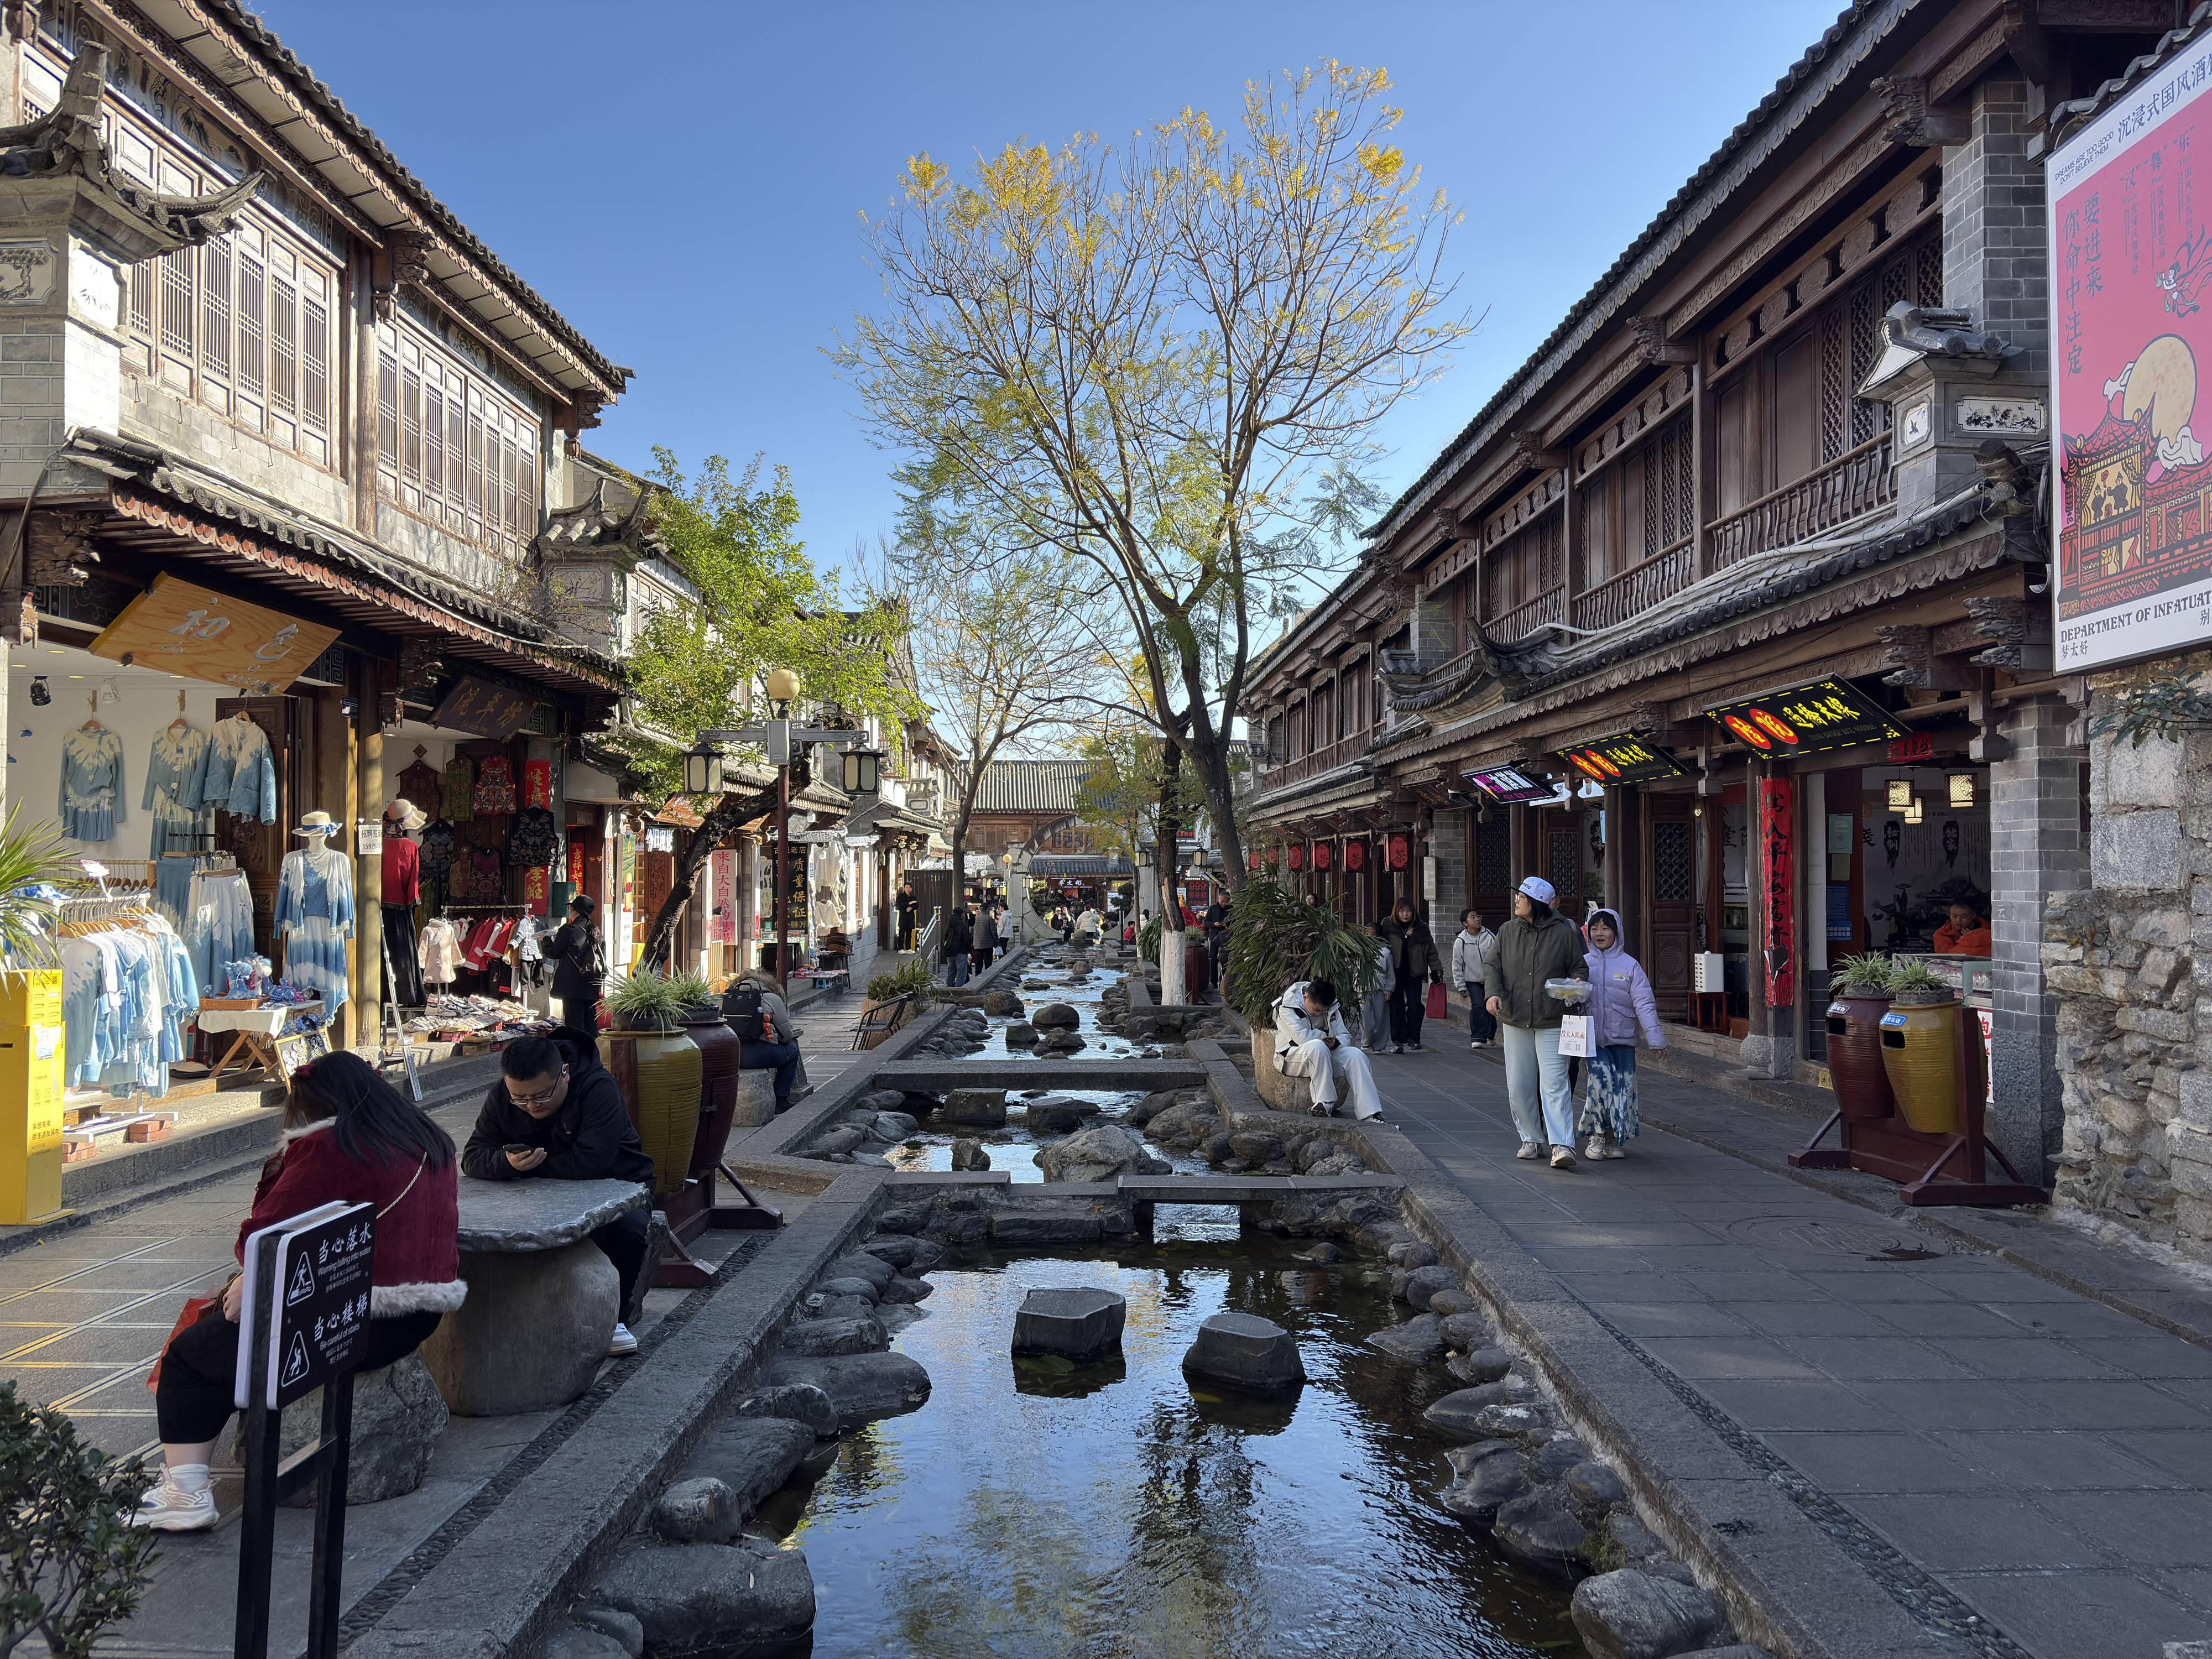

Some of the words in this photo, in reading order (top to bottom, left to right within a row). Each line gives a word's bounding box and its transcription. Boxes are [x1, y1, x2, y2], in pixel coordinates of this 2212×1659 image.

[2055, 161, 2075, 180] DREAMS
[2075, 153, 2085, 165] ARE
[2086, 144, 2097, 157] TOO
[2098, 131, 2114, 148] GOOD
[2060, 170, 2075, 185] DON'T
[2075, 155, 2094, 176] BELIEVE
[2095, 144, 2109, 159] THEM
[2084, 191, 2103, 300] 要进来
[2063, 209, 2083, 381] 你命中注定
[2060, 612, 2132, 643] DEPARTMENT
[2136, 607, 2151, 623] OF
[2061, 640, 2089, 661] 梦太好
[1820, 729, 1844, 738] BRIDGE
[1851, 723, 1878, 732] NOODLE
[792, 858, 806, 918] 质量保证
[1190, 882, 1206, 890] 999
[32, 1129, 59, 1140] 给生活加满电
[33, 1120, 51, 1130] 美团充电
[317, 1263, 337, 1277] Warning
[338, 1256, 350, 1268] falling
[351, 1253, 359, 1261] into
[359, 1246, 372, 1257] water
[319, 1222, 372, 1265] 当心落水
[314, 1291, 368, 1342] 当心楼梯
[320, 1340, 327, 1350] Be
[327, 1331, 343, 1347] careful
[343, 1328, 348, 1337] of
